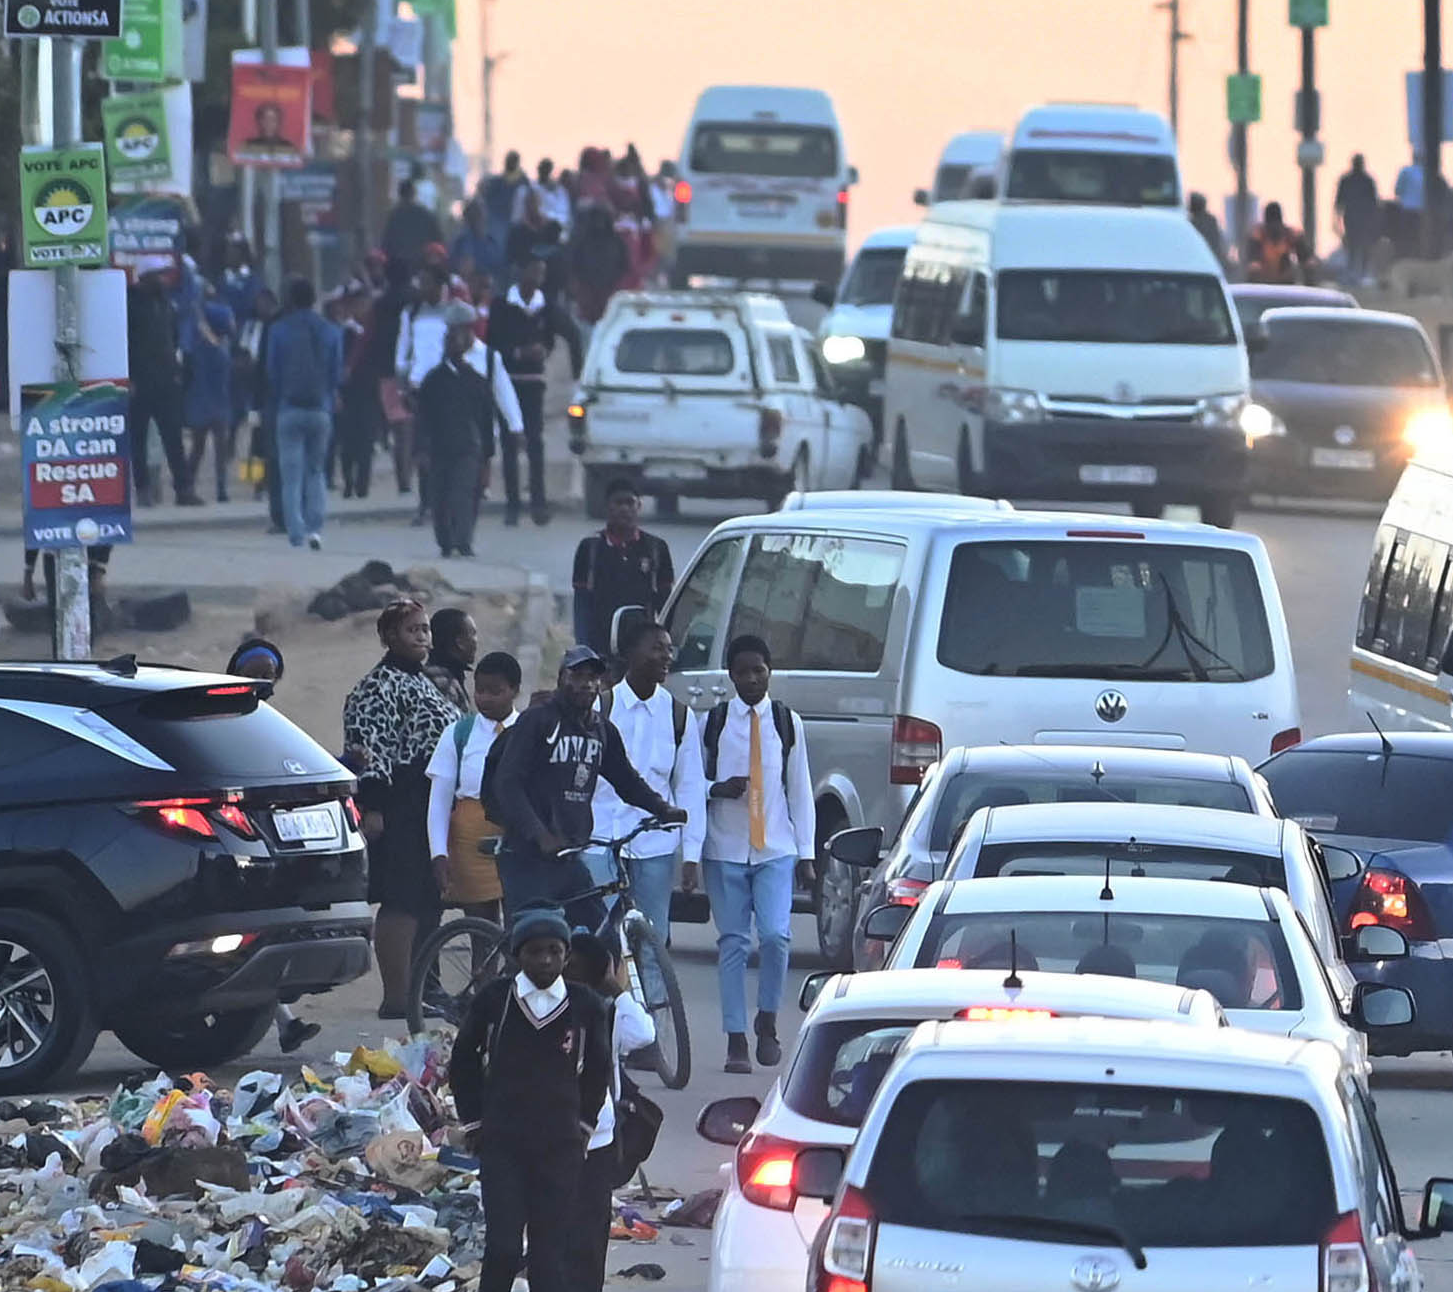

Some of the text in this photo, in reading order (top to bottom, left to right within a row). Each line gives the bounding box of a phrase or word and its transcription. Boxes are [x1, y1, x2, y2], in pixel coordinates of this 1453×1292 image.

[44, 10, 109, 26] ACTIONSA
[24, 158, 99, 172] VOTE APC
[44, 209, 85, 225] APC
[26, 414, 125, 436] A strong
[36, 438, 116, 457] DA can
[36, 462, 118, 482] Rescue
[61, 483, 95, 503] SA
[33, 524, 126, 541] VOTE DA
